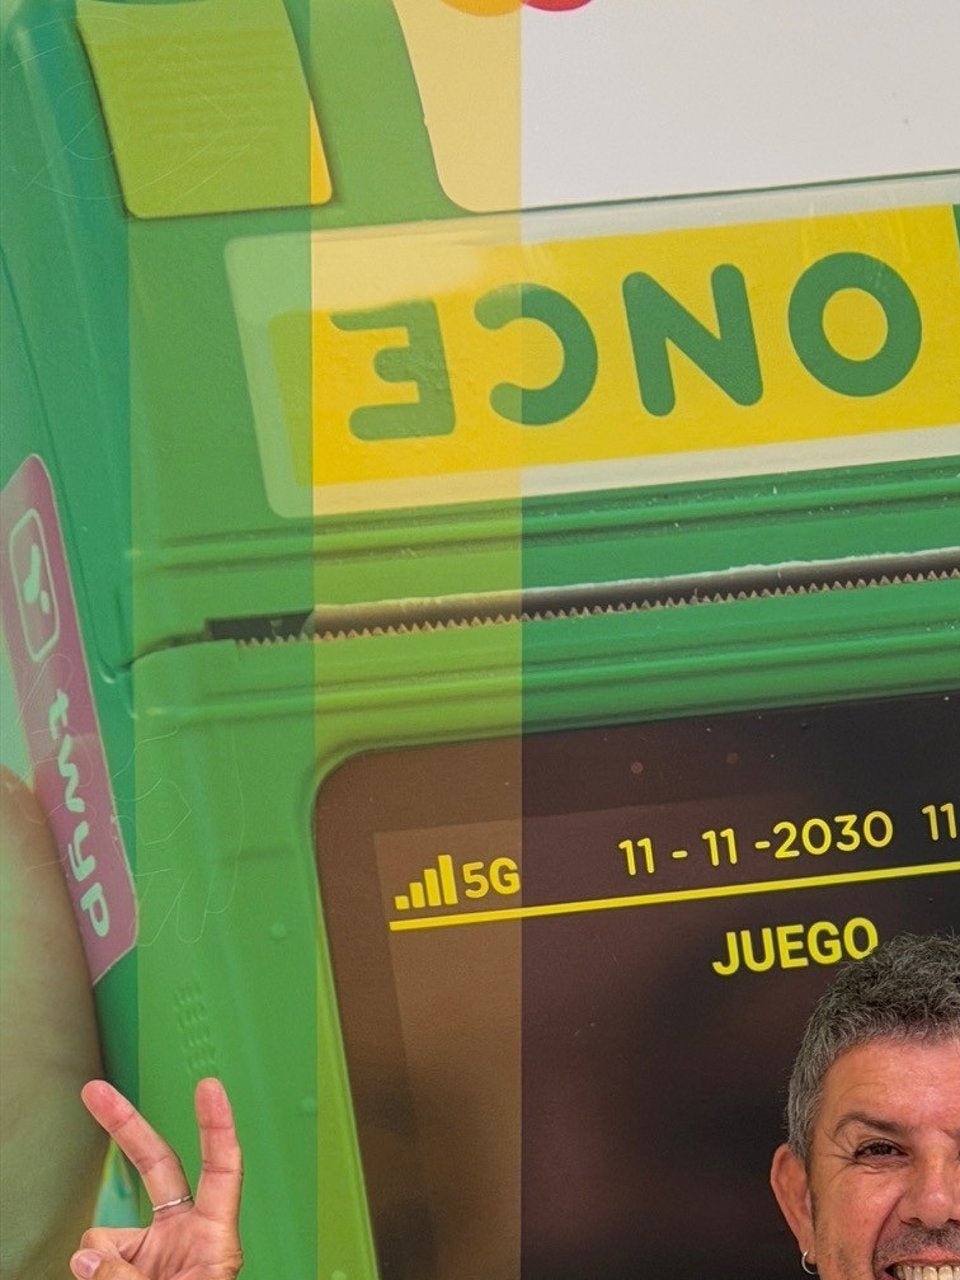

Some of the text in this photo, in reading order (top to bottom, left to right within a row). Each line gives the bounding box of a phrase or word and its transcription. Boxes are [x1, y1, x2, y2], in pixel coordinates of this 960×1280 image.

[329, 251, 922, 441] ONCE
[48, 689, 110, 938] twyp
[462, 857, 520, 899] 5G
[618, 837, 655, 876] 11
[702, 828, 738, 866] 11
[921, 802, 957, 841] 11
[712, 916, 878, 976] JUEGO
